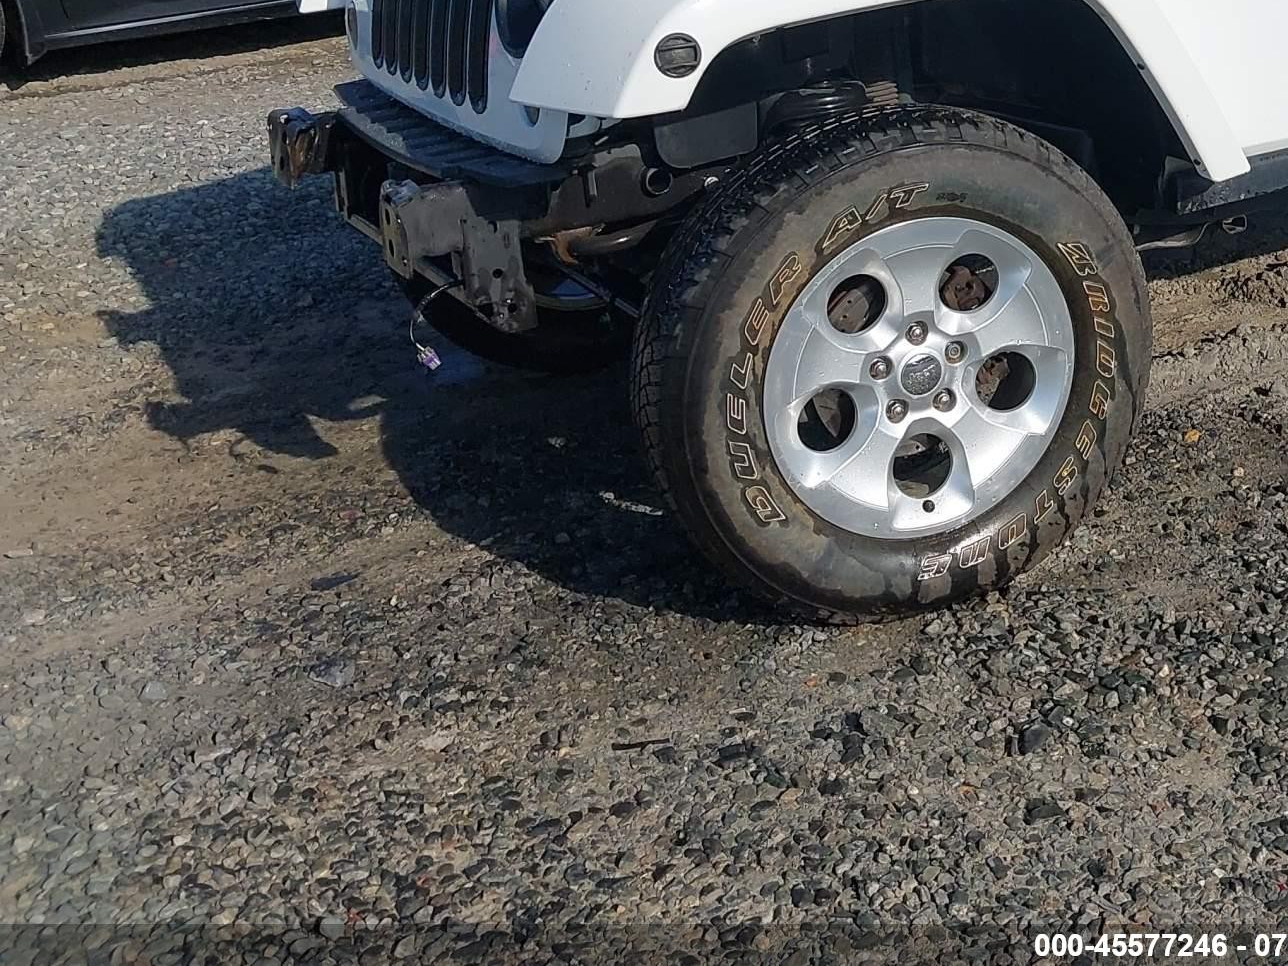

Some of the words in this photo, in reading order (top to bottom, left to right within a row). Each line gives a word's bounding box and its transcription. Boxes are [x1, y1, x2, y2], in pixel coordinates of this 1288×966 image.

[725, 251, 802, 524] DUELER
[822, 182, 930, 248] A/T
[917, 241, 1116, 581] BRIDGESTONE
